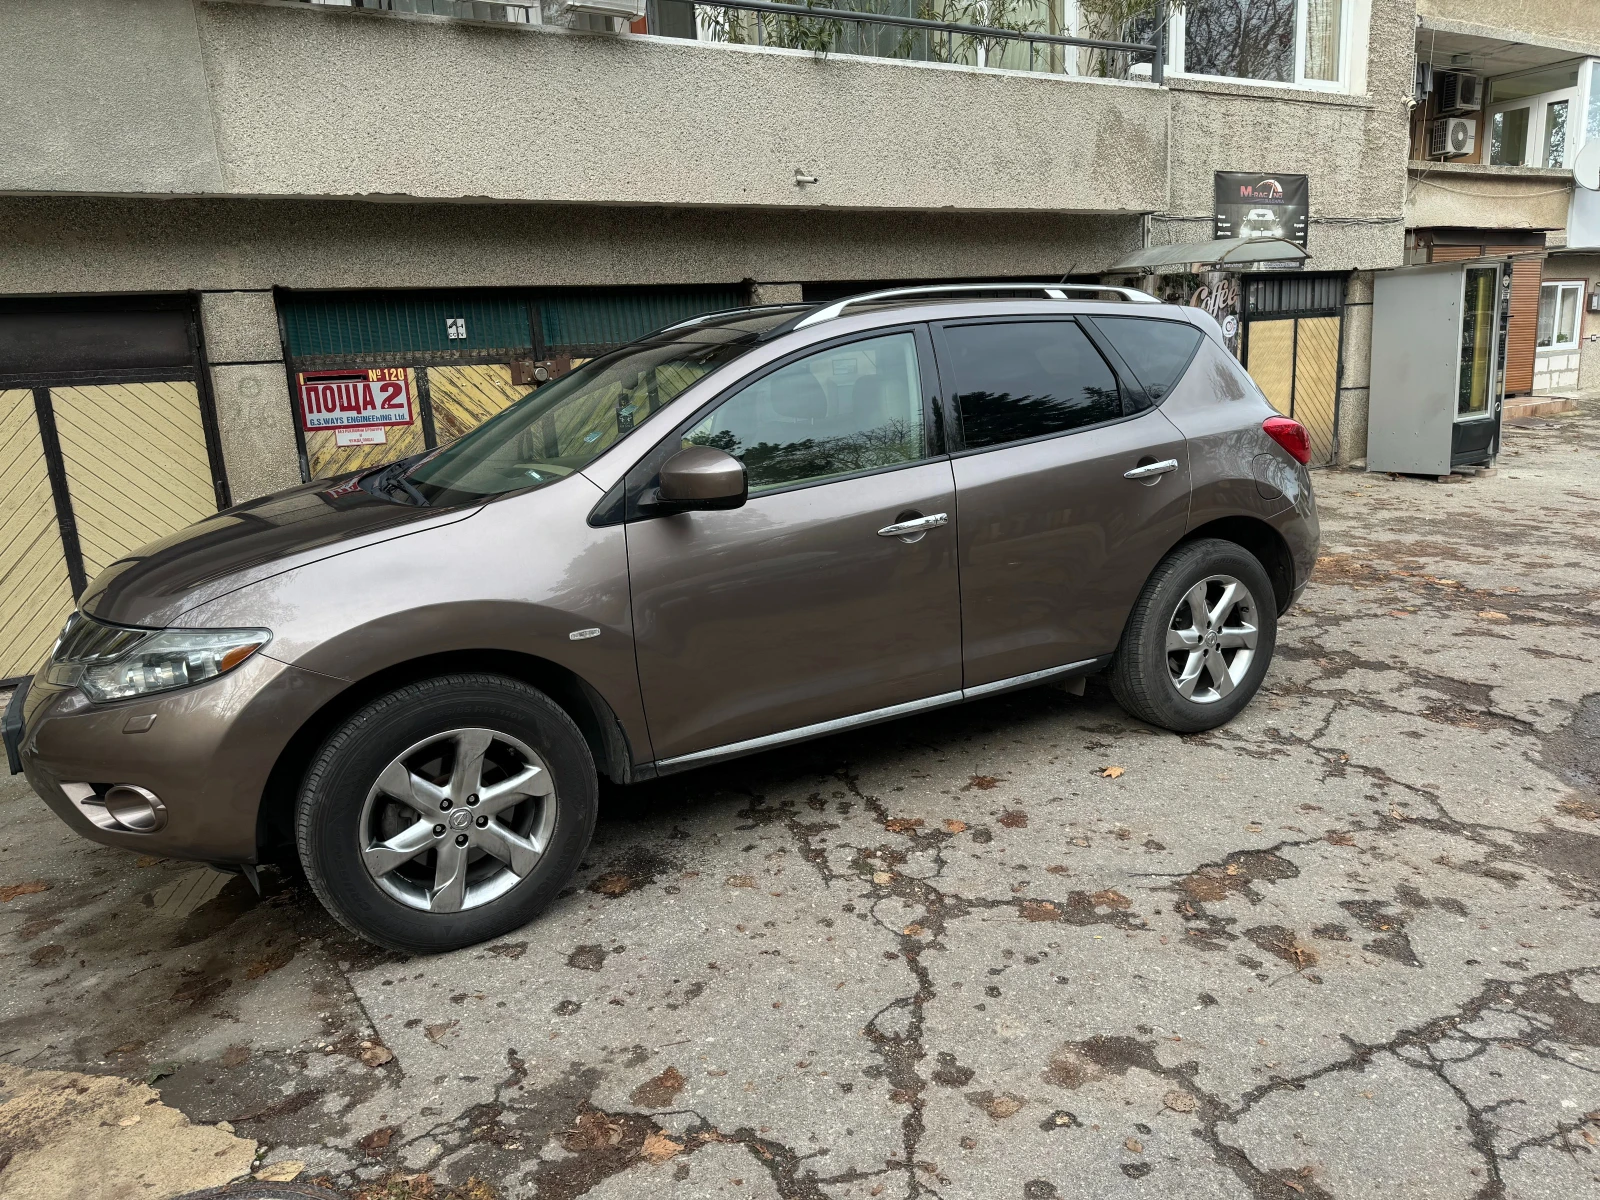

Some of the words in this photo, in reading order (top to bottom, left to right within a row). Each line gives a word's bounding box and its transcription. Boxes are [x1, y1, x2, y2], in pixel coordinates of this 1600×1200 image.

[1190, 280, 1237, 317] Coffee
[384, 368, 404, 381] 120
[305, 383, 377, 415] ПОЩА
[380, 382, 404, 409] 2
[310, 416, 344, 426] G.S.WAYS
[394, 413, 407, 421] Ltd.
